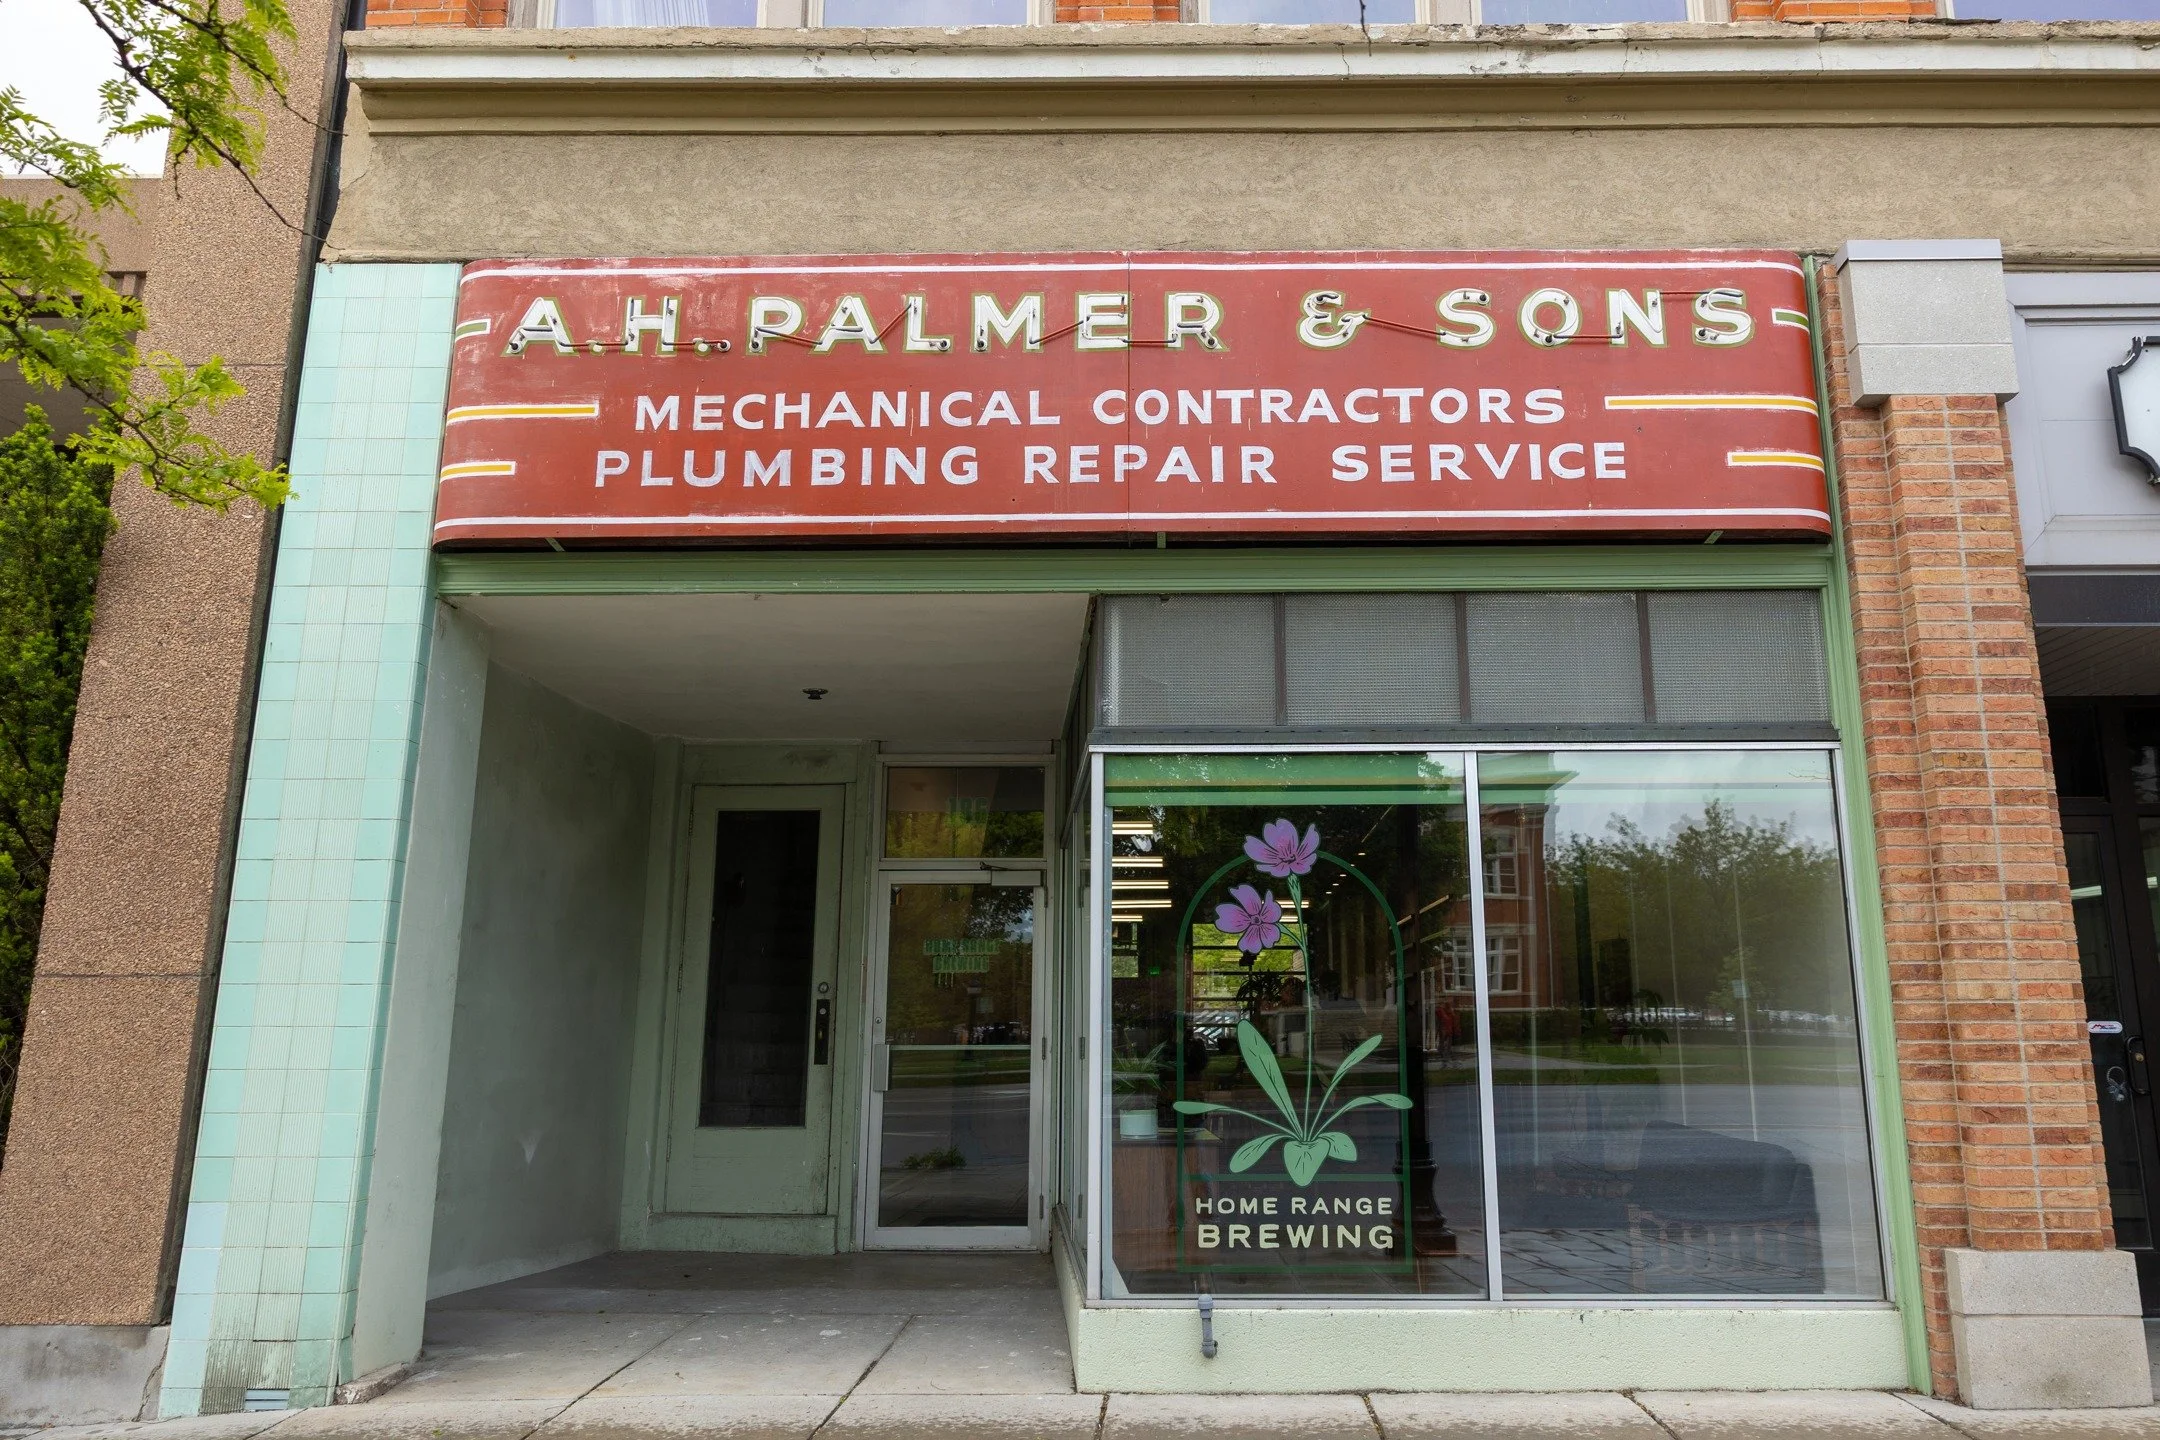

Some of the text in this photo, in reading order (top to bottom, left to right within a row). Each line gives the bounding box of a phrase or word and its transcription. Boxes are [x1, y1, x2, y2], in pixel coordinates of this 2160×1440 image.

[748, 292, 1227, 354] PALMER
[1298, 290, 1369, 348] &
[1435, 288, 1752, 348] SONS
[635, 388, 1565, 430] MECHANICAL CONTRACTORS
[595, 442, 1626, 487] PLUMBING REPAIR SERVICE
[1195, 1197, 1393, 1215] HOME RANGE
[1197, 1223, 1393, 1249] BREWING
